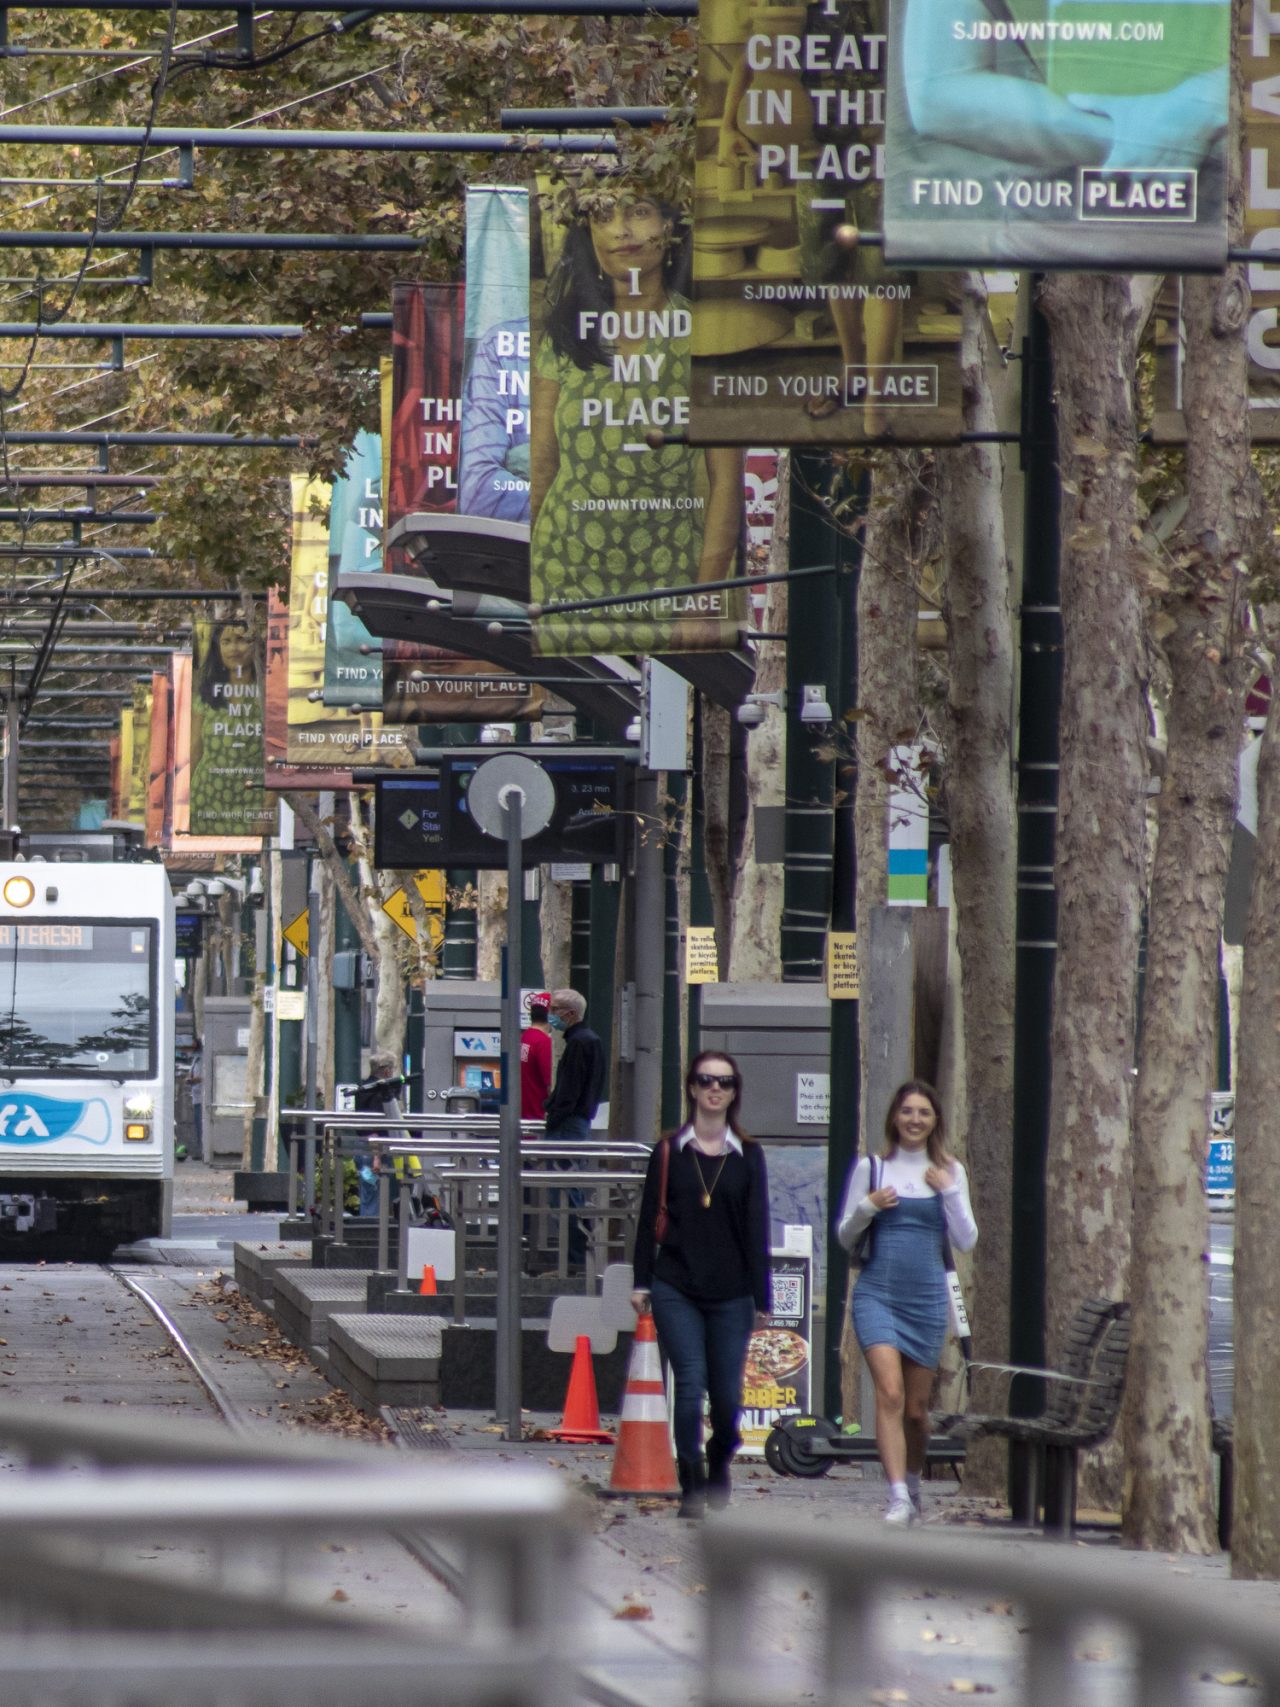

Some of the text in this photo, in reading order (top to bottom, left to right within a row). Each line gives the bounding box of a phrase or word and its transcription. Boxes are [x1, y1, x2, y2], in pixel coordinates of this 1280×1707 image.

[952, 21, 1165, 41] SJDOWNTOWN.COM
[747, 34, 887, 70] CREAT
[746, 89, 885, 125] IN THI
[912, 178, 1187, 208] FIND YOUR PLACE
[628, 267, 642, 296] I
[744, 285, 911, 300] SJDOWNTOWN.COM
[579, 309, 693, 340] FOUND
[613, 354, 666, 382] MY
[497, 369, 530, 396] IN
[713, 375, 930, 396] FIND YOUR PLACE
[582, 396, 691, 426] PLACE
[423, 432, 453, 455] IN
[427, 466, 458, 489] PL
[572, 497, 705, 512] SJDOWNTOWN.COM
[358, 507, 384, 528] IN
[660, 594, 722, 613] PLACE
[336, 667, 368, 680] FIND
[396, 680, 528, 694] FIND YOUR PLACE
[228, 703, 253, 717] MY
[298, 733, 403, 744] FIND YOUR PLACE
[20, 925, 82, 946] TERESA
[833, 942, 843, 950] No
[833, 952, 857, 960] skateb
[833, 972, 858, 981] permitt
[843, 962, 857, 972] bicy
